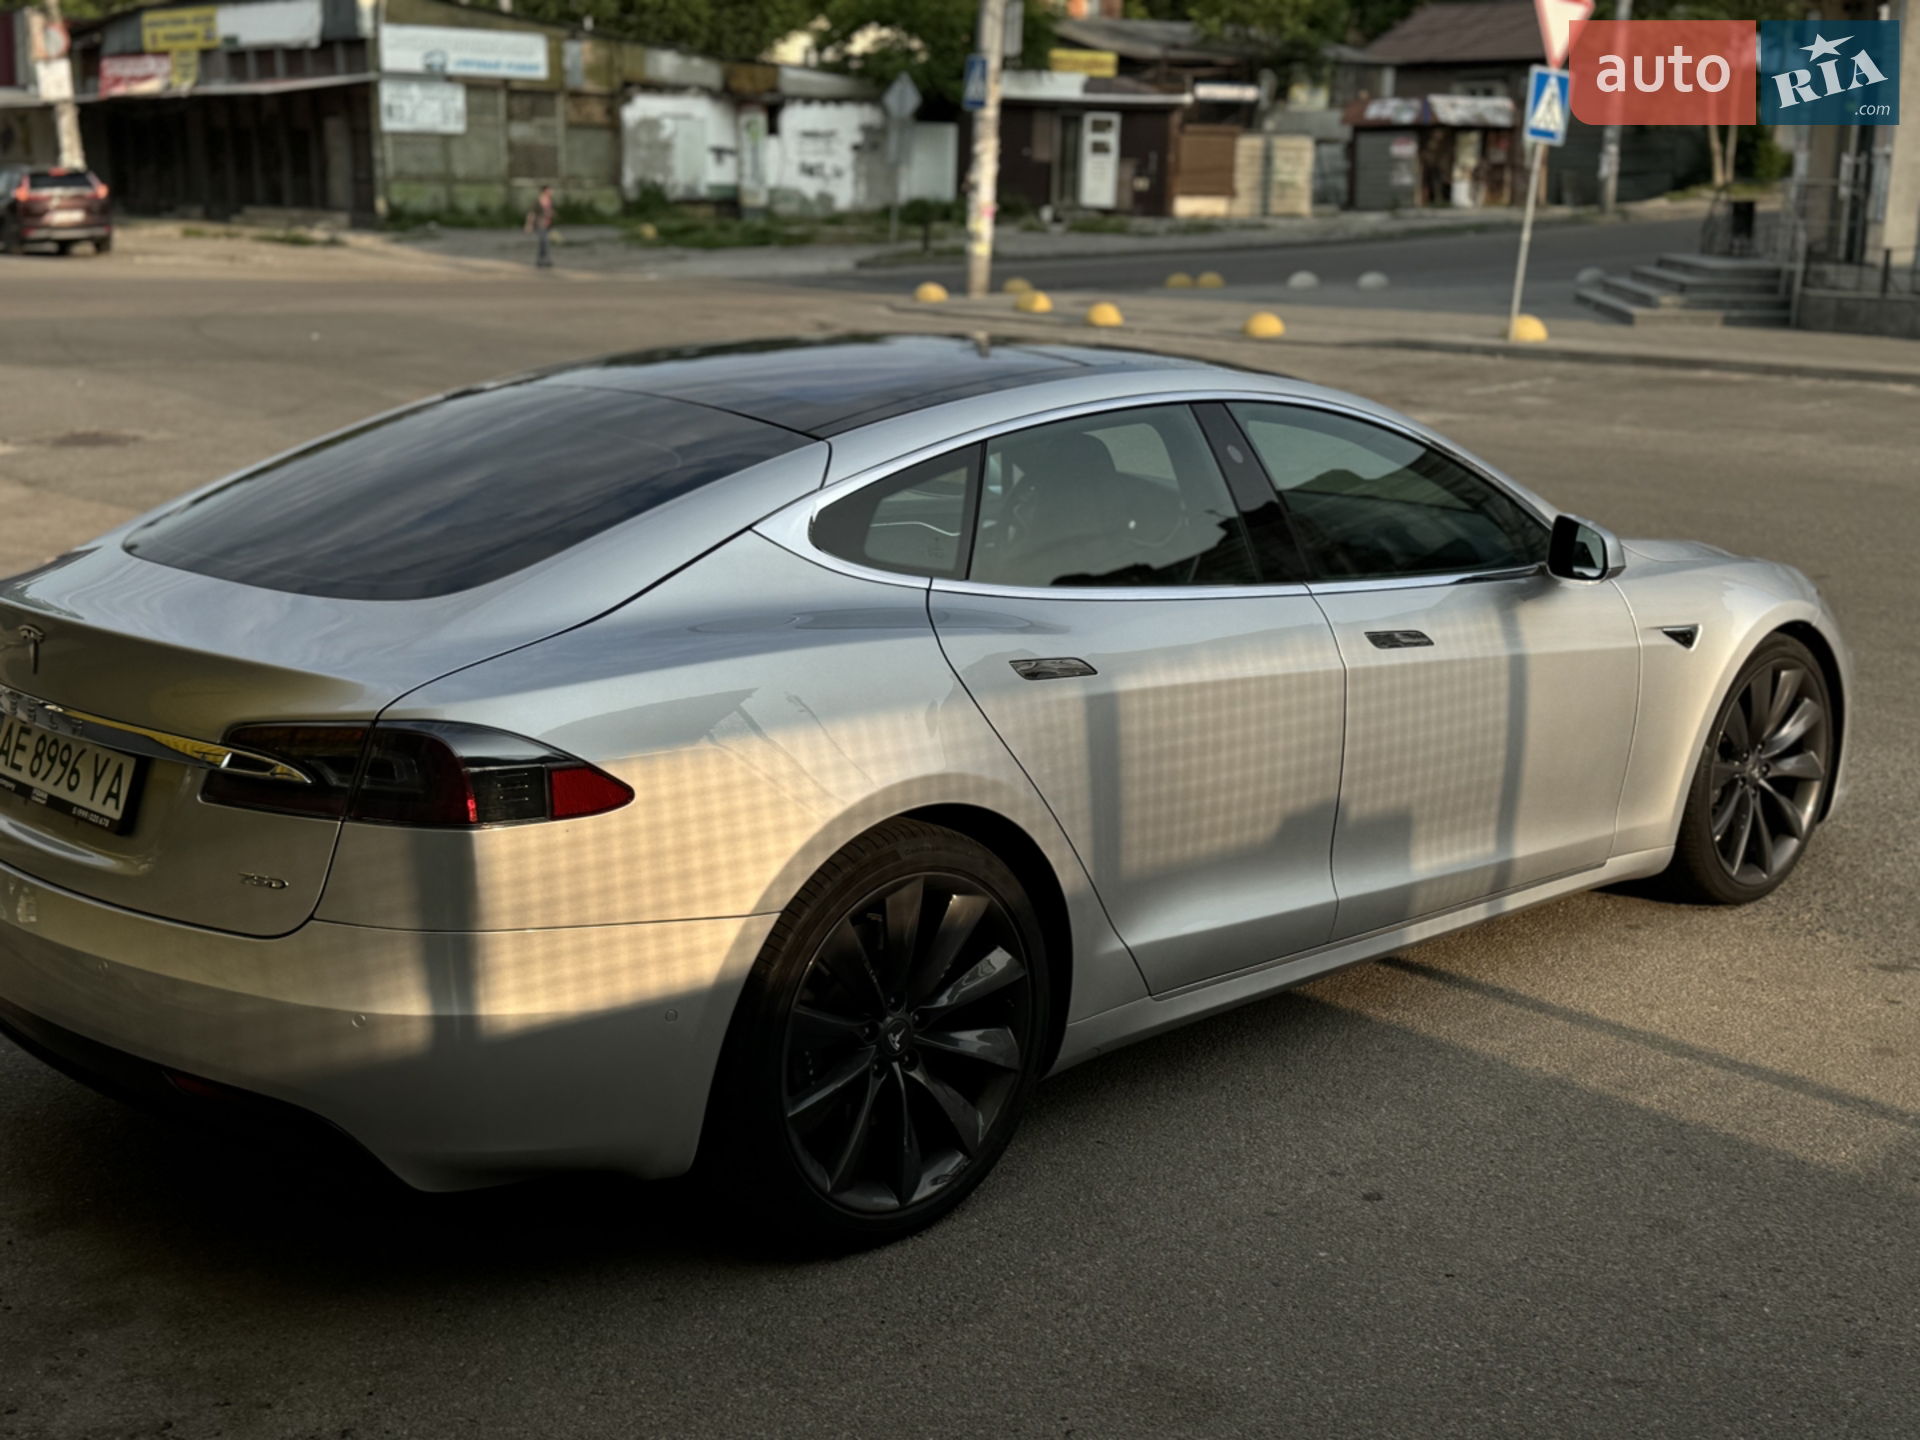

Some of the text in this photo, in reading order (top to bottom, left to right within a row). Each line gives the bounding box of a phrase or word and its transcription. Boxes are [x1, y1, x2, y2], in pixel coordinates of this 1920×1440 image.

[0, 722, 124, 811] AE 8996 YA
